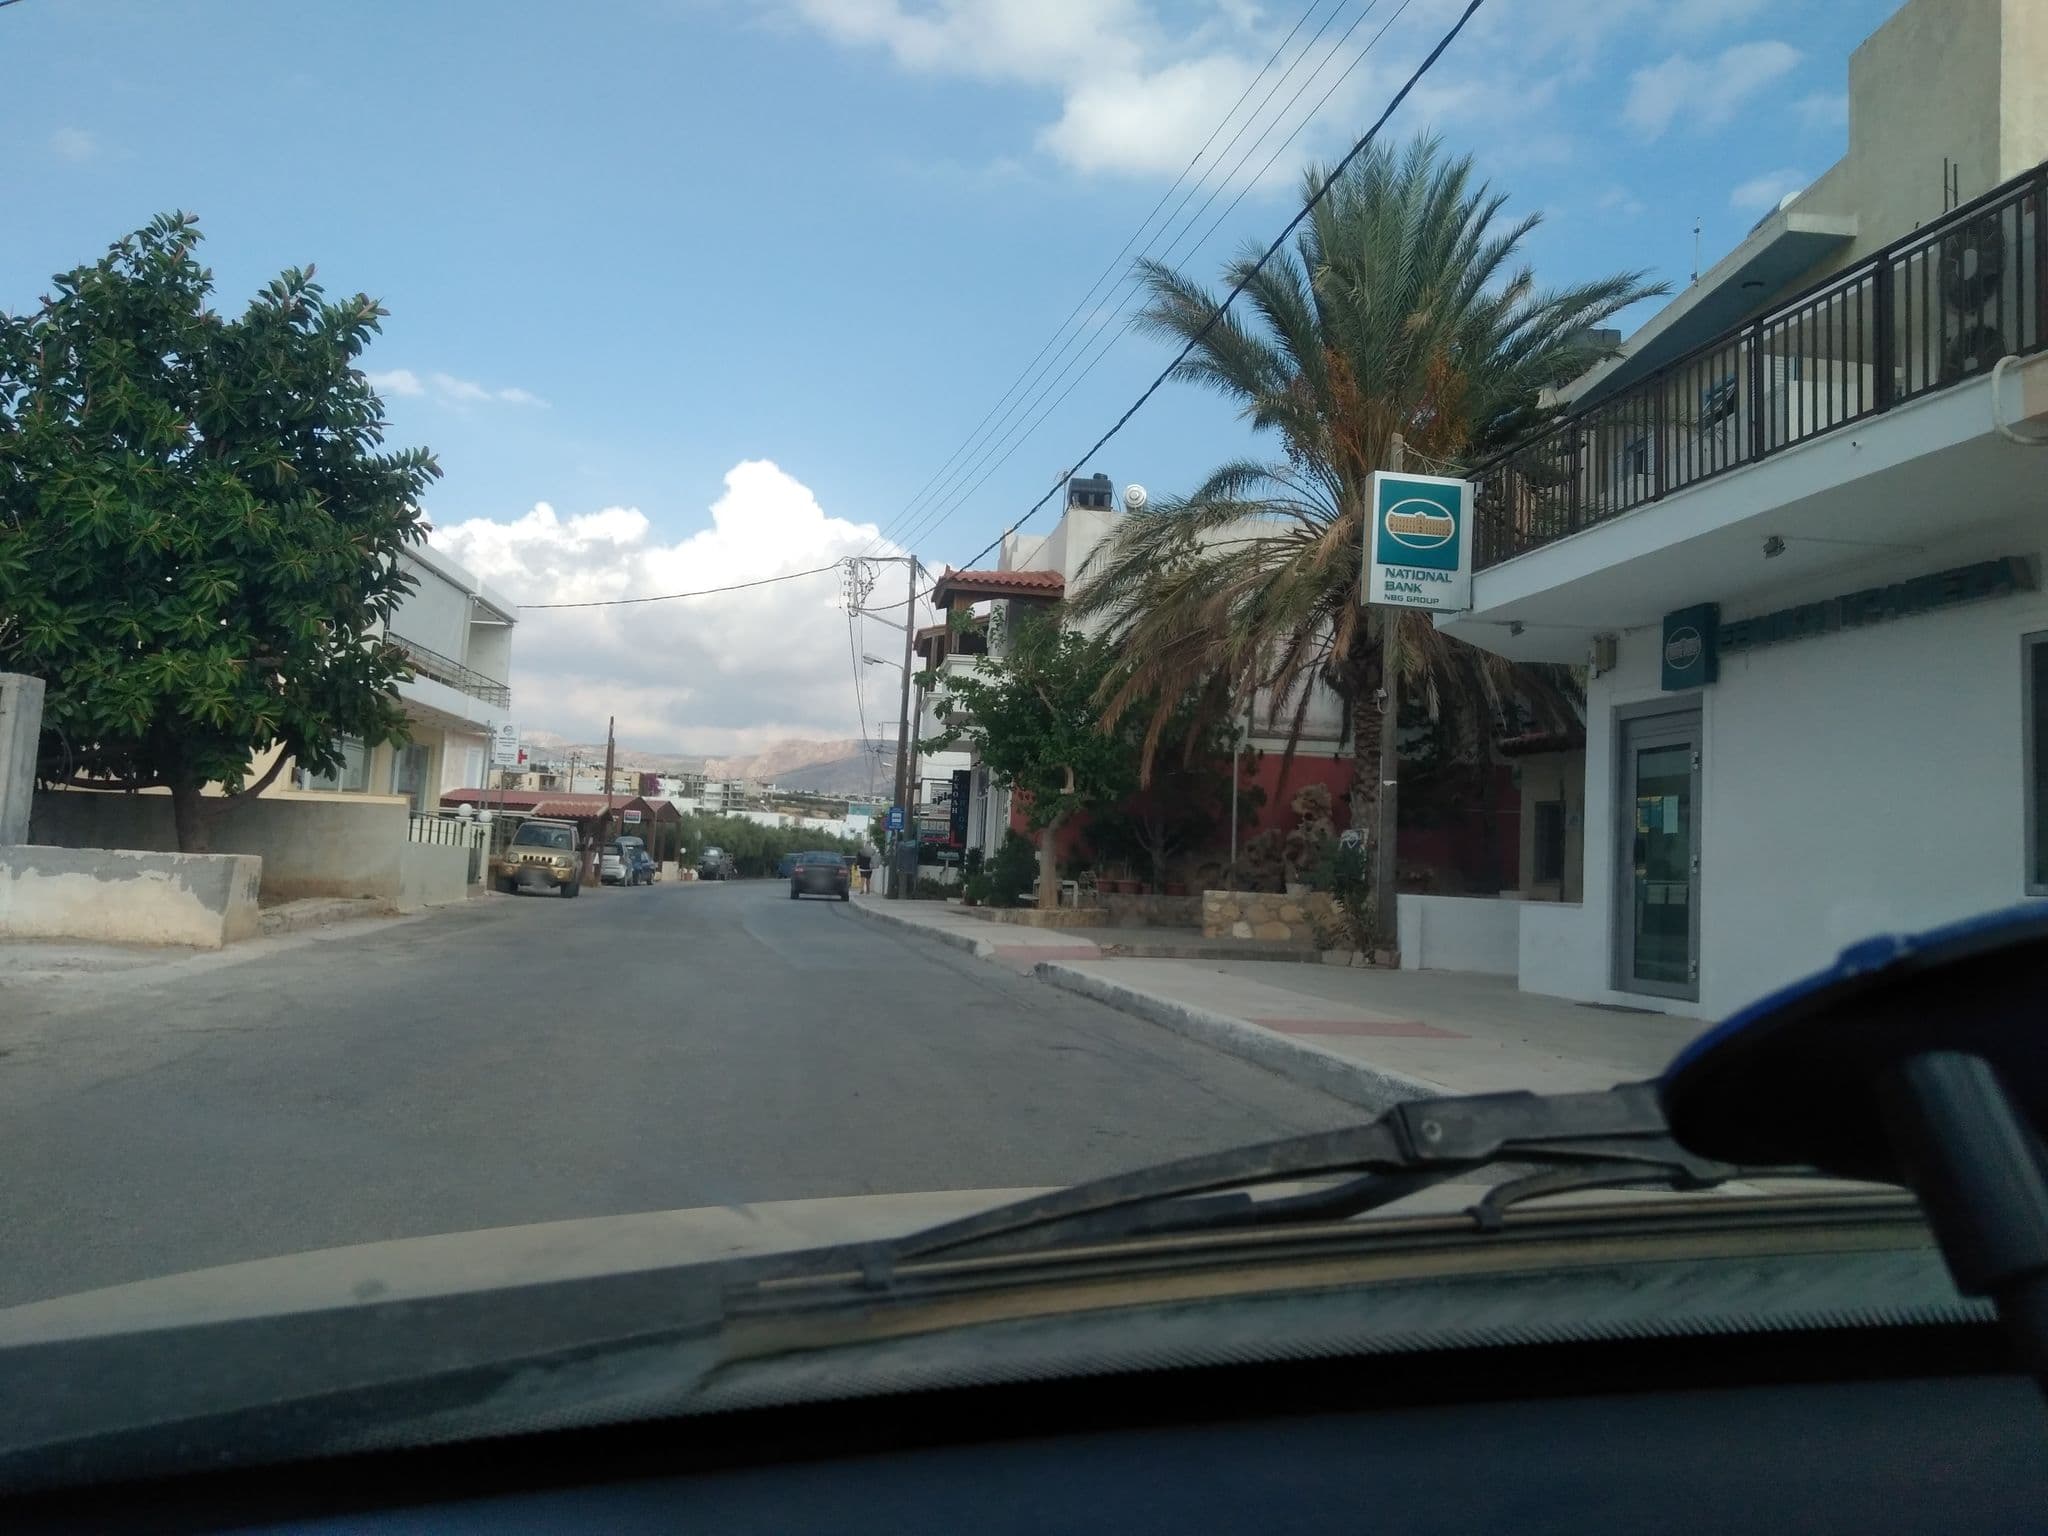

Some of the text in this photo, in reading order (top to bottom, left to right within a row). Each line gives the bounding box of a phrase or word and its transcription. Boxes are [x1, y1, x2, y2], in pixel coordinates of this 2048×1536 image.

[1385, 567, 1453, 583] NATIONAL
[1384, 581, 1422, 594] BANK
[1384, 593, 1440, 604] NBG GROUP
